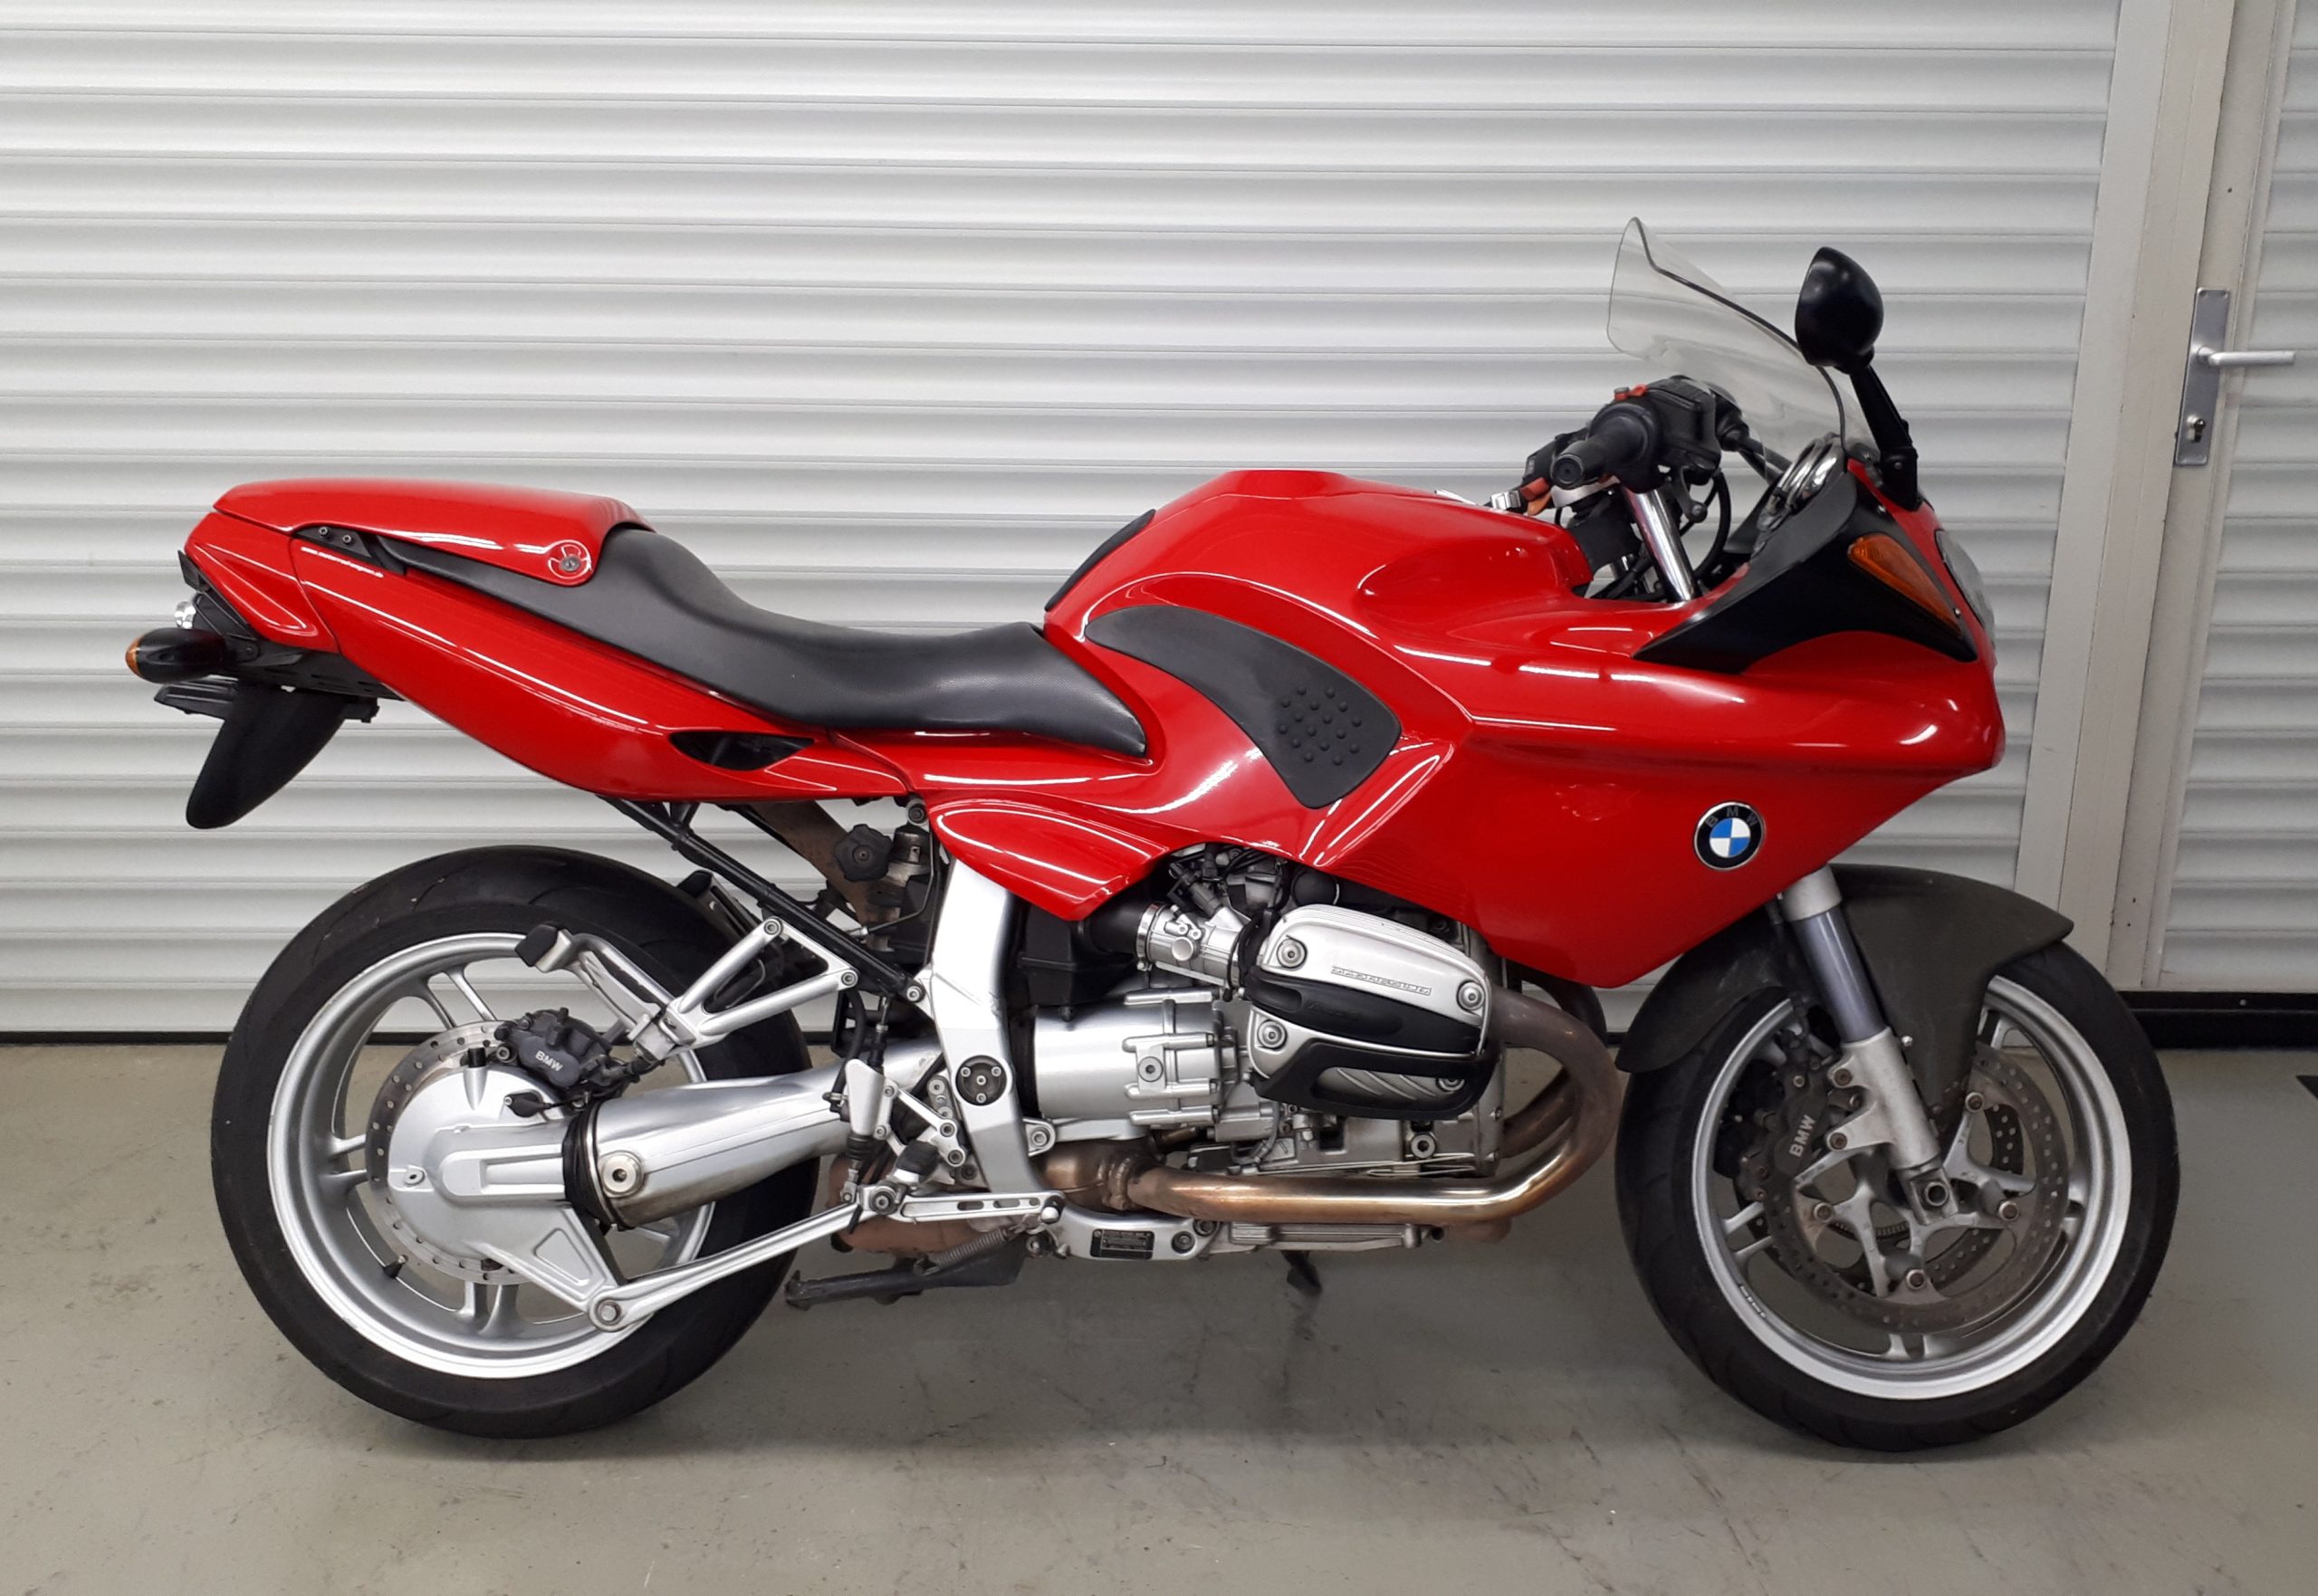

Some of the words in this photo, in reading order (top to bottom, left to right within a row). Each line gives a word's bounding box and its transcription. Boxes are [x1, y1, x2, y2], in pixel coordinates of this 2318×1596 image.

[1705, 806, 1758, 827] BMW
[535, 1050, 563, 1072] BMW
[1789, 1113, 1815, 1158] BMW
